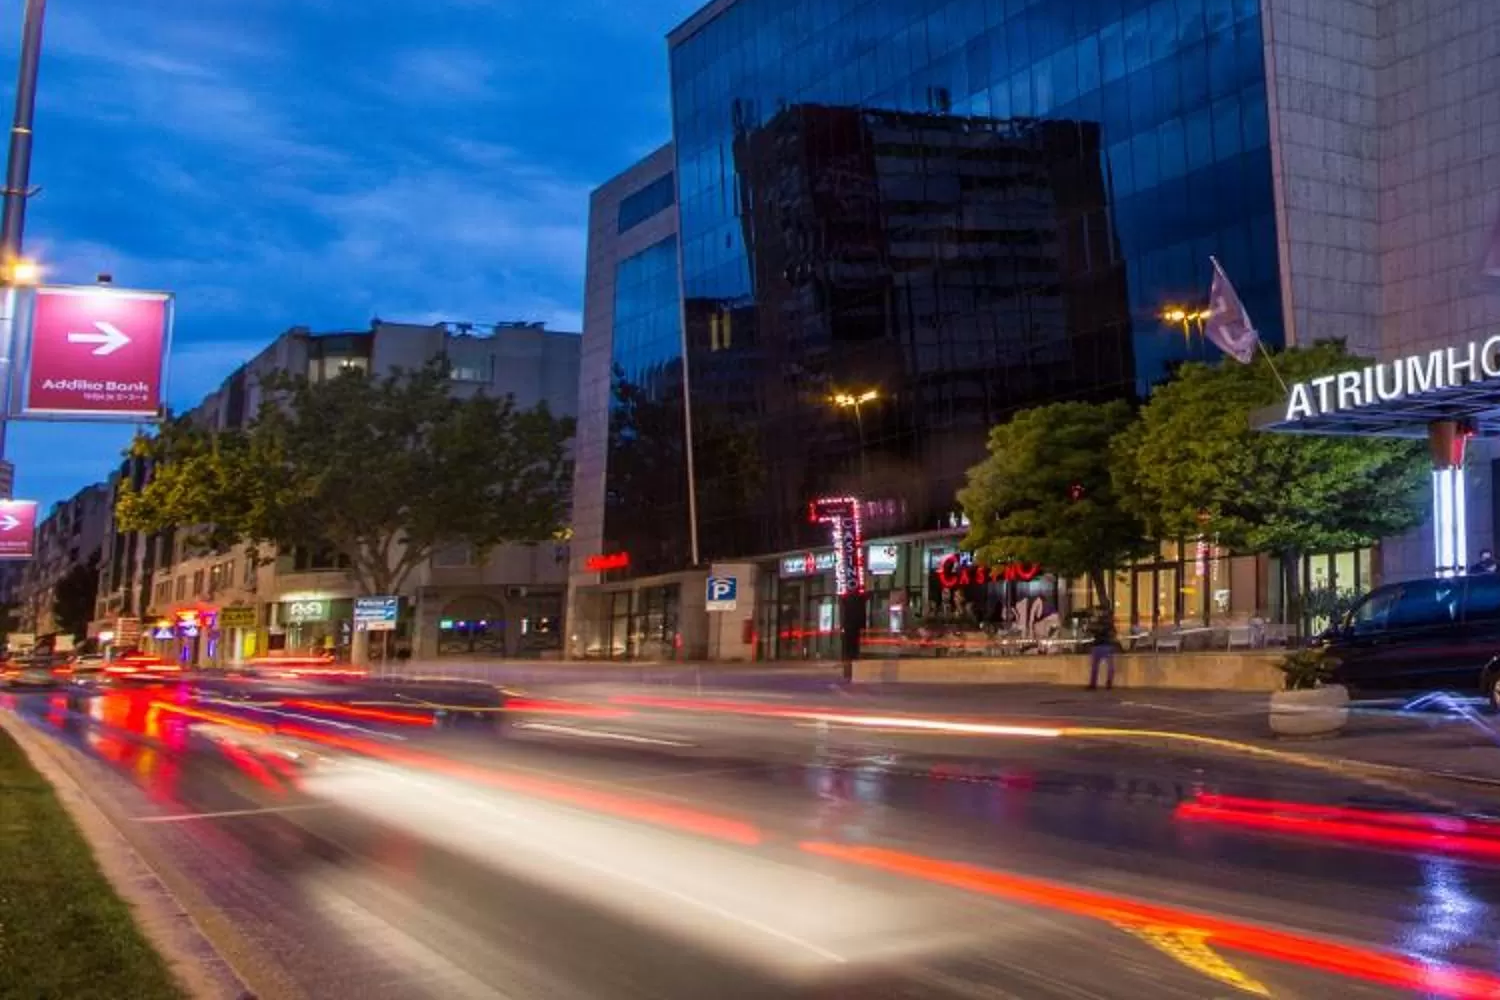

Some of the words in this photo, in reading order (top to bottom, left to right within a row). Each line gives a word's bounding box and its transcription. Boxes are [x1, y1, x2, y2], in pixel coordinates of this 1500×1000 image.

[105, 381, 149, 392] Bank
[842, 517, 858, 591] CASINO
[713, 583, 730, 600] P
